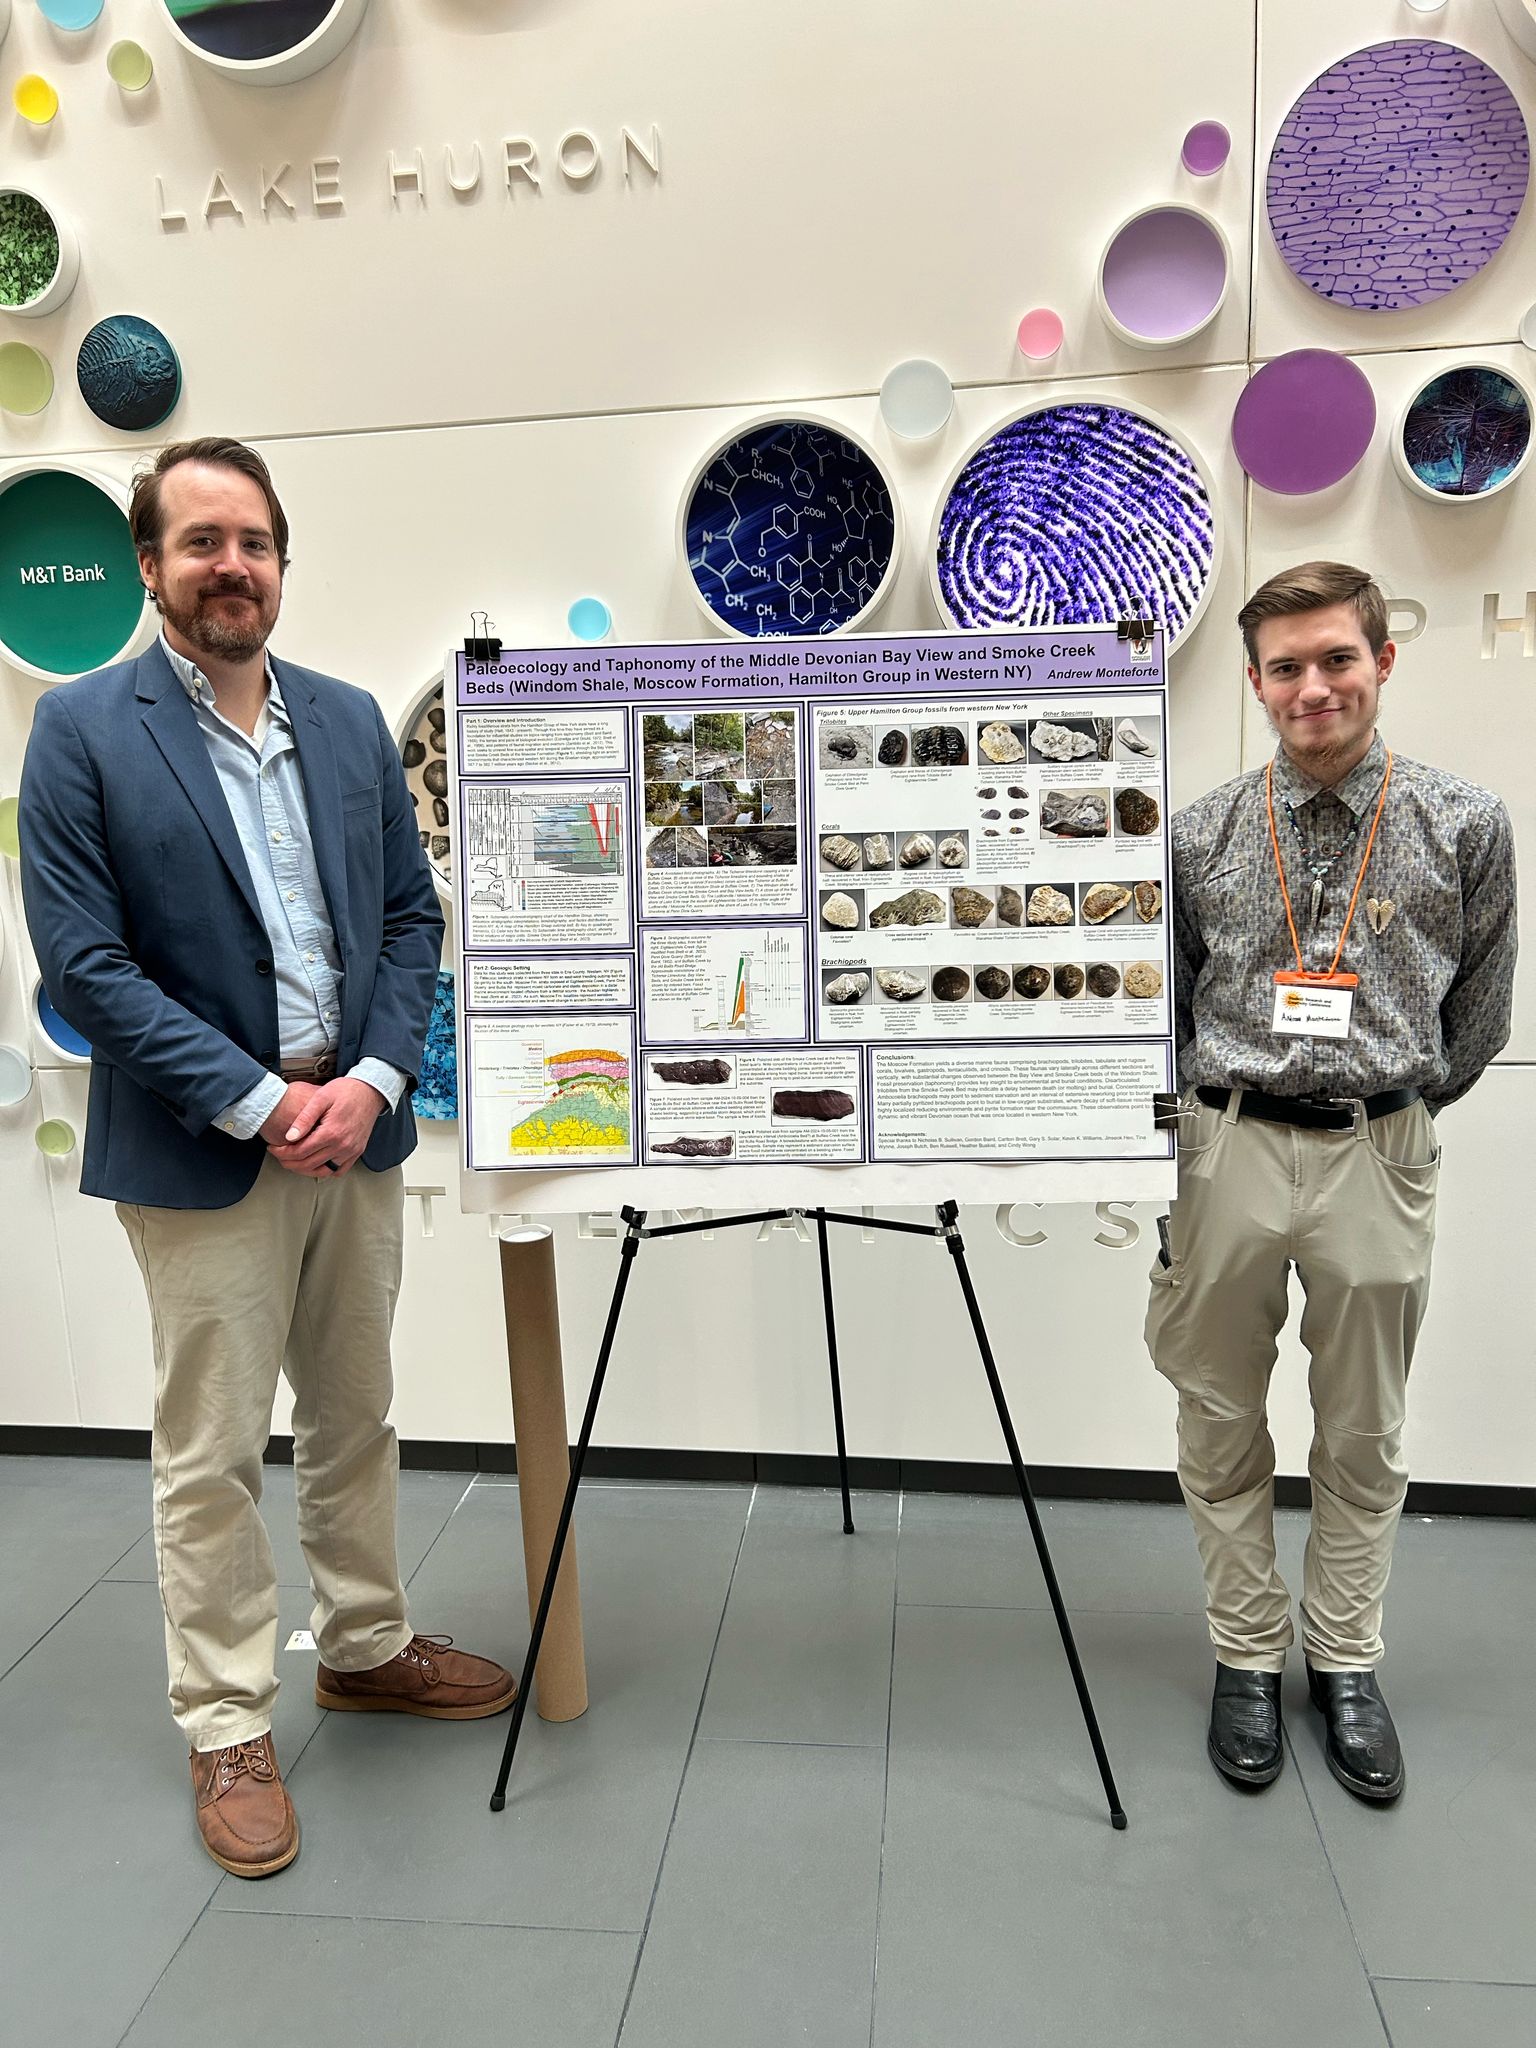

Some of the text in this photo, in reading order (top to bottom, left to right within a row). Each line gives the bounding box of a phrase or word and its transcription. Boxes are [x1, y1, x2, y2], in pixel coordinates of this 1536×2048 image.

[155, 123, 661, 222] LAKE HURON
[804, 506, 826, 519] COOH
[20, 564, 106, 584] M&T Bank
[466, 644, 1095, 678] Paleoecology and Taphonomy of the Middle Devonian Bay View and Smoke Creek
[466, 666, 1031, 697] Beds (Windom Shale, Moscow Formation, Hamilton Group in Western NY)
[1048, 666, 1159, 680] Andrew Monteforte
[816, 710, 838, 718] Figure
[821, 958, 867, 966] Brachiopods
